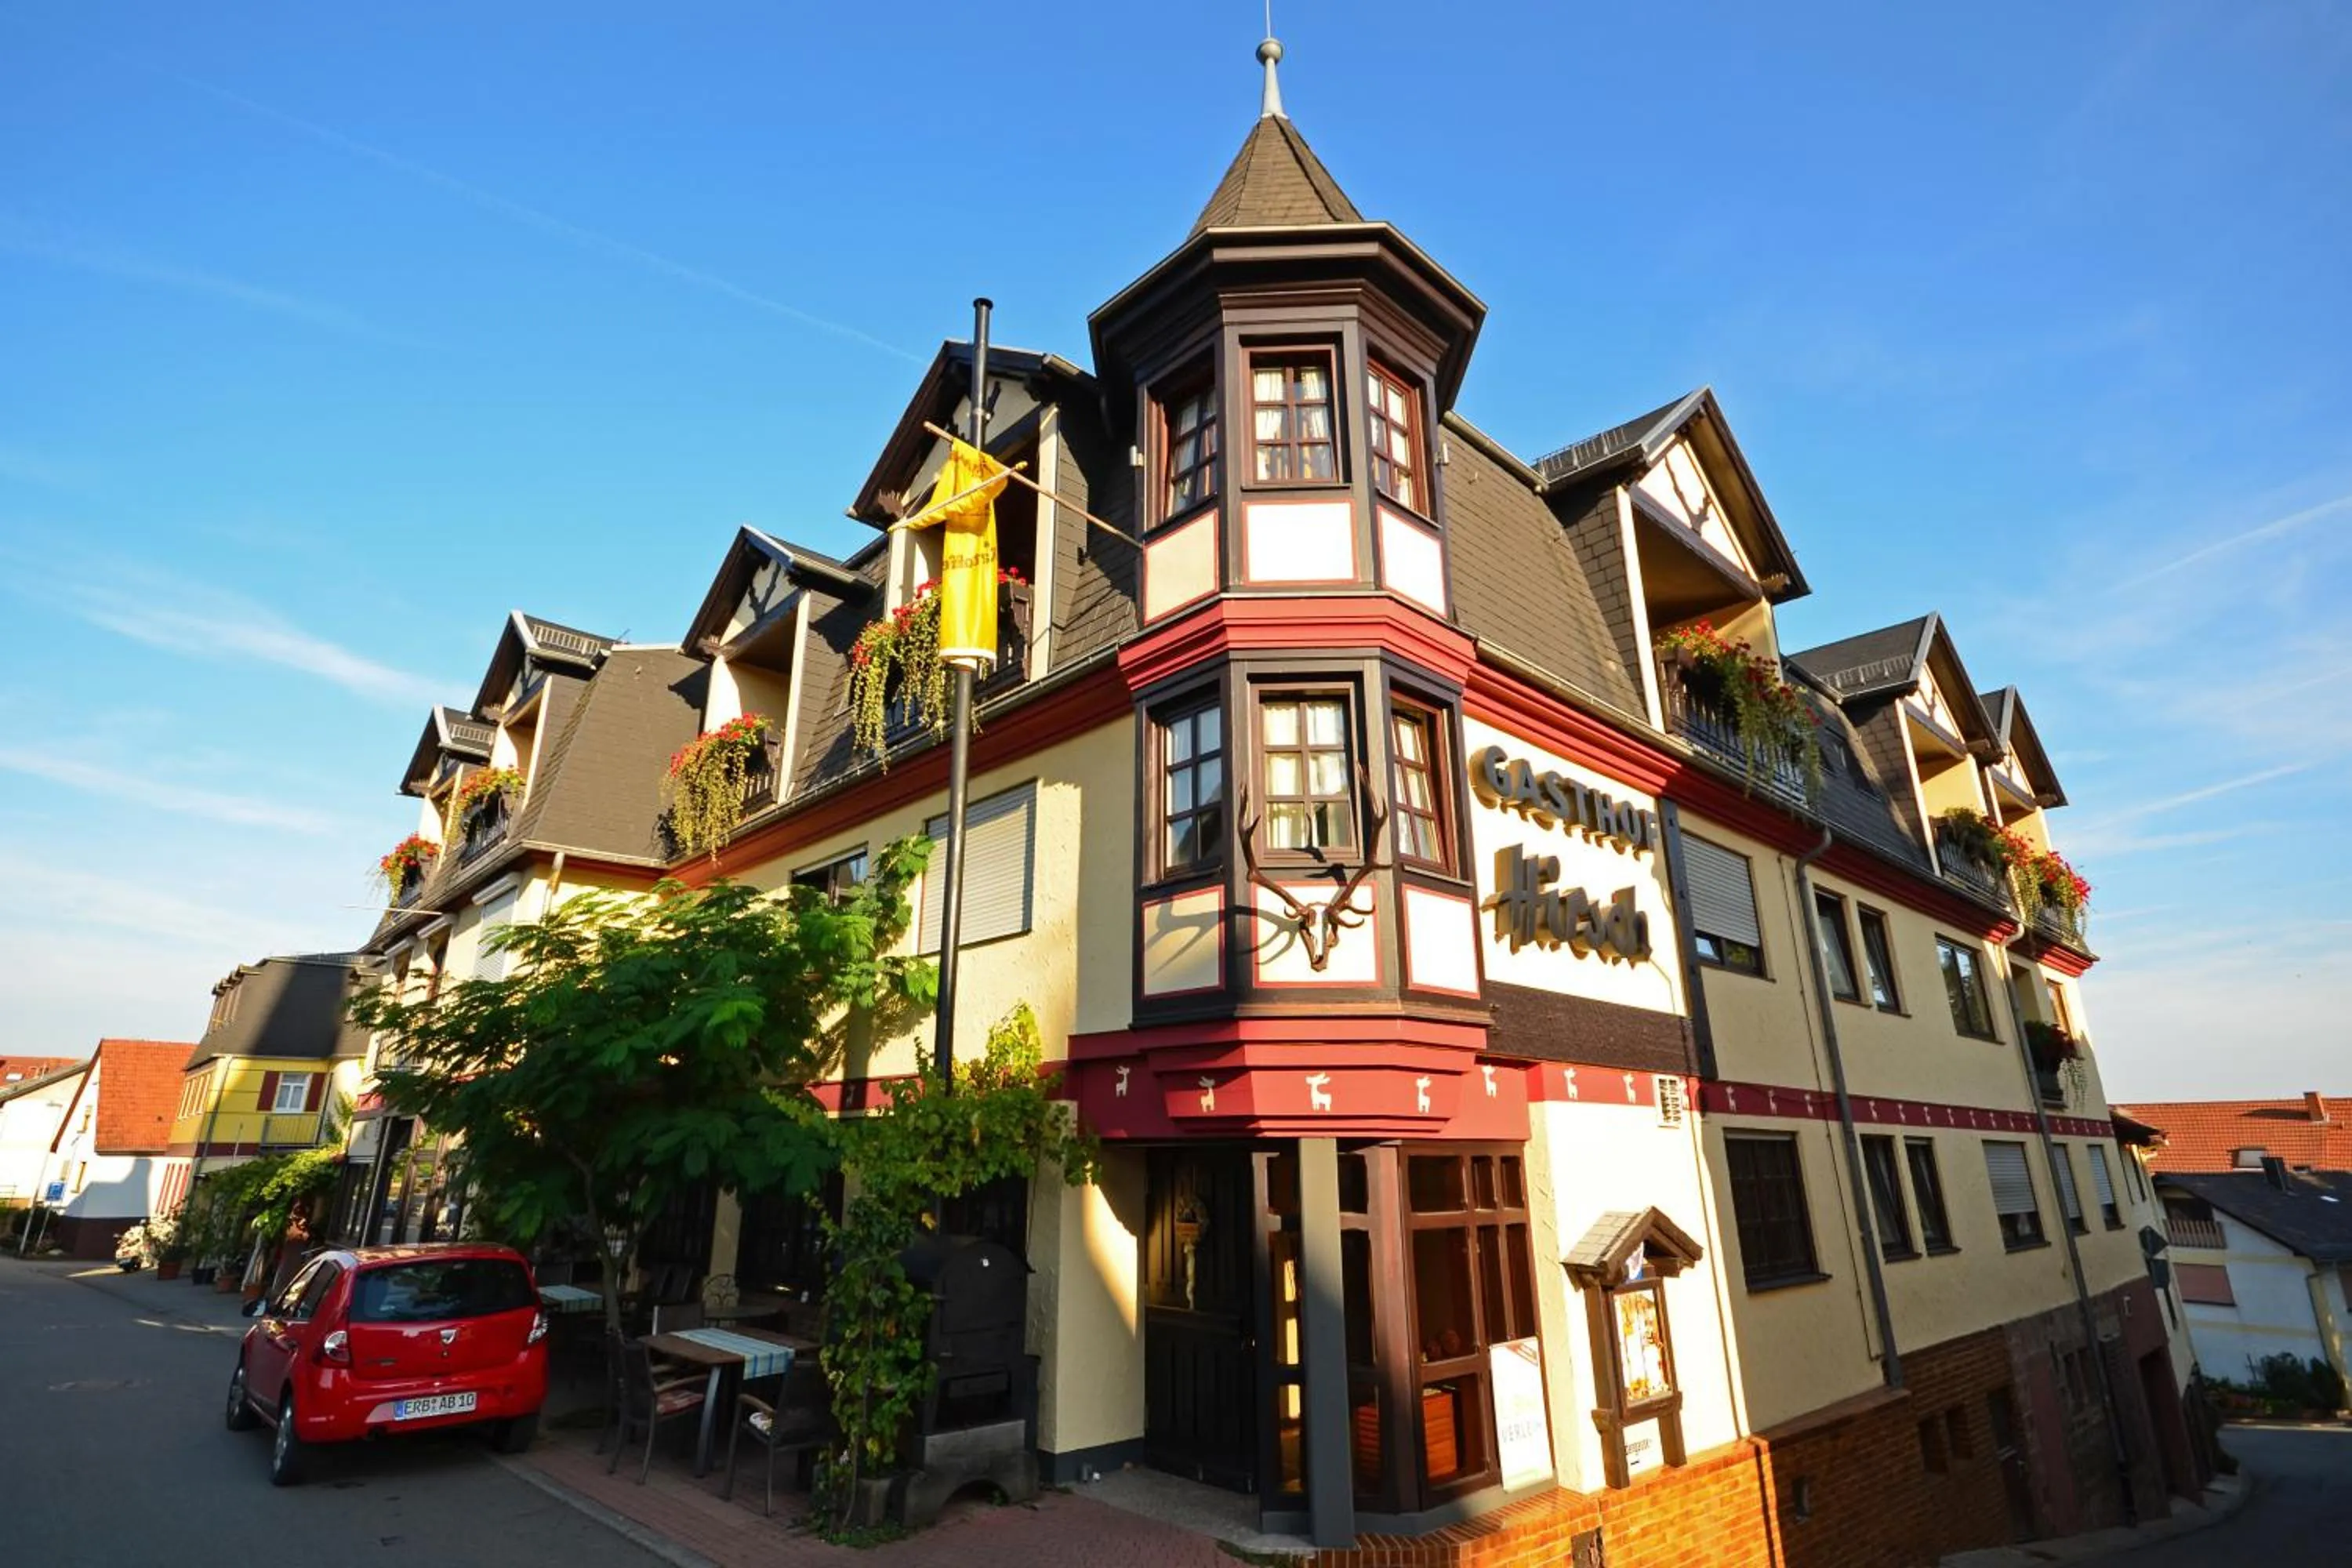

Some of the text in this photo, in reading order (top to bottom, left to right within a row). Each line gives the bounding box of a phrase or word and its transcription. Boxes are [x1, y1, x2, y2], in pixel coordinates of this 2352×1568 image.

[1470, 746, 1658, 859] GASTHOF
[1483, 844, 1652, 967] Hirsch
[405, 1394, 474, 1414] ERB AB 10
